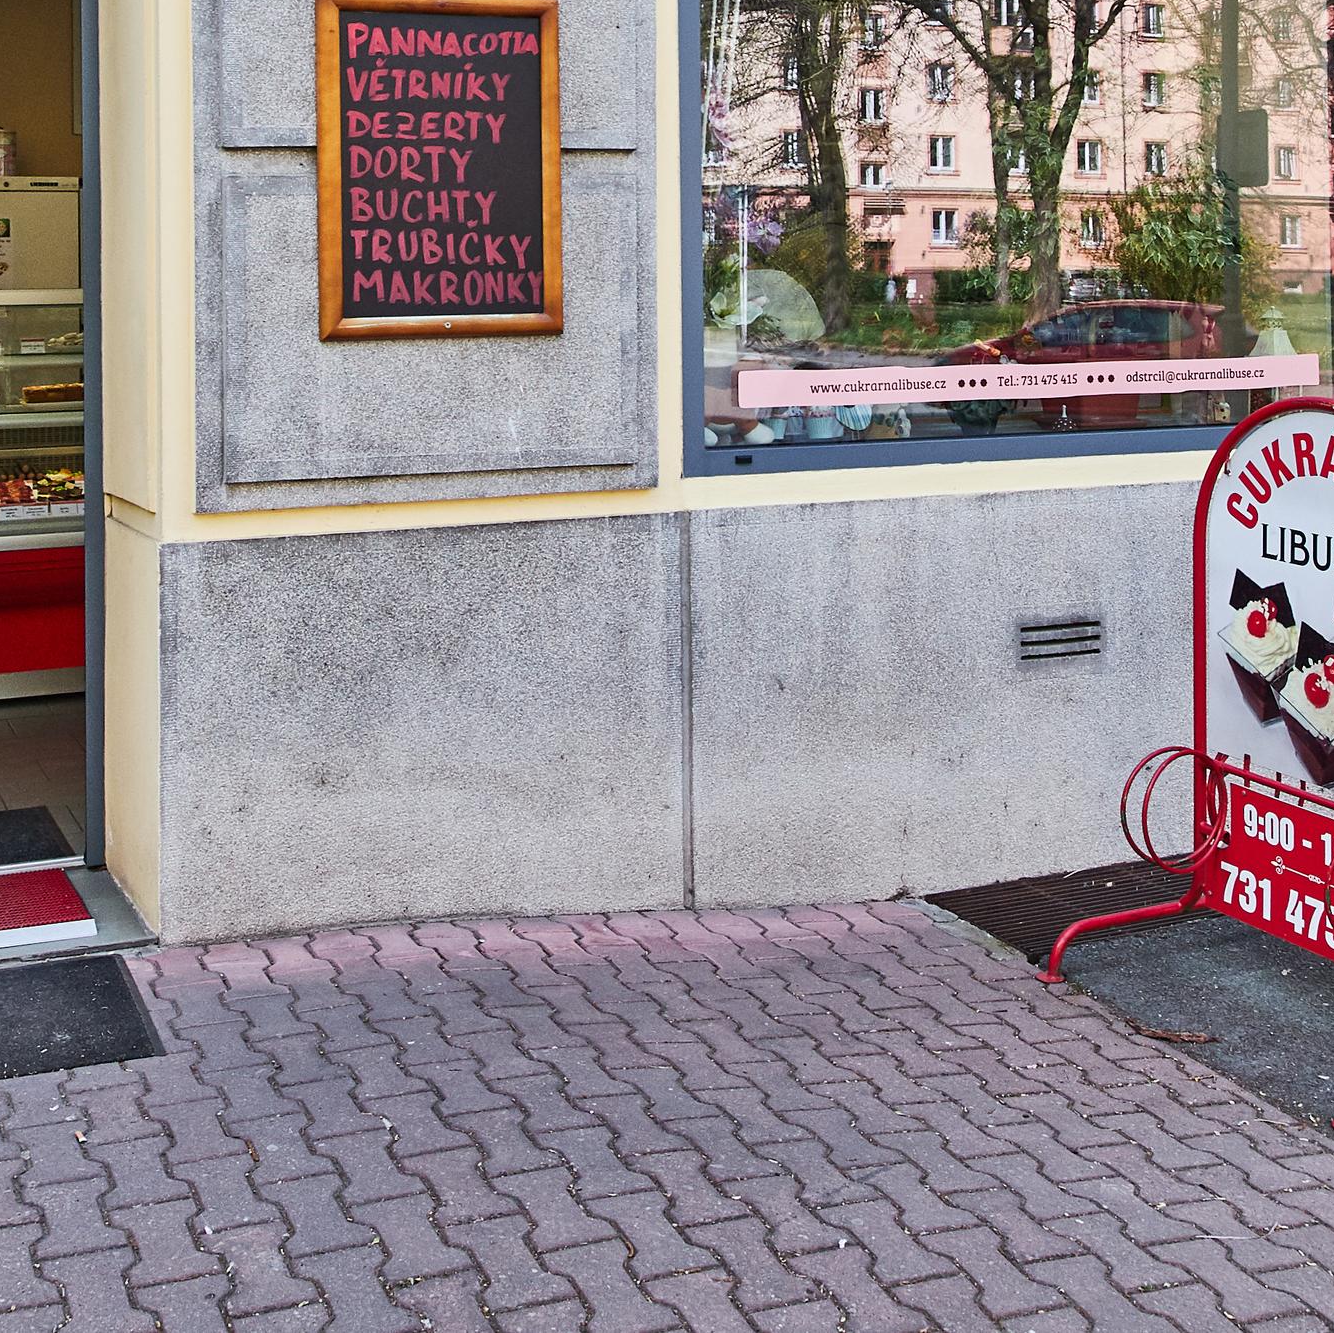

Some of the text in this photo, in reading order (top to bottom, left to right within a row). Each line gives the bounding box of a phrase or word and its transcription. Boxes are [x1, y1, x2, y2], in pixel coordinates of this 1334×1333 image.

[346, 21, 540, 59] PANNACOTTA
[346, 57, 512, 102] VĚTRNÍKY
[346, 109, 508, 145] DEZERTY
[348, 144, 474, 184] DORTY
[348, 185, 498, 226] BUCHTY
[349, 219, 533, 270] TRUBIČKY
[352, 268, 543, 307] MAKRONKY
[809, 367, 1266, 394] www.cukrarnalibuse.cz Tel.: 731 475 415 odstrcil@cukrarnalibuse.cz
[1243, 803, 1295, 852] 9:00
[1220, 861, 1272, 922] 731
